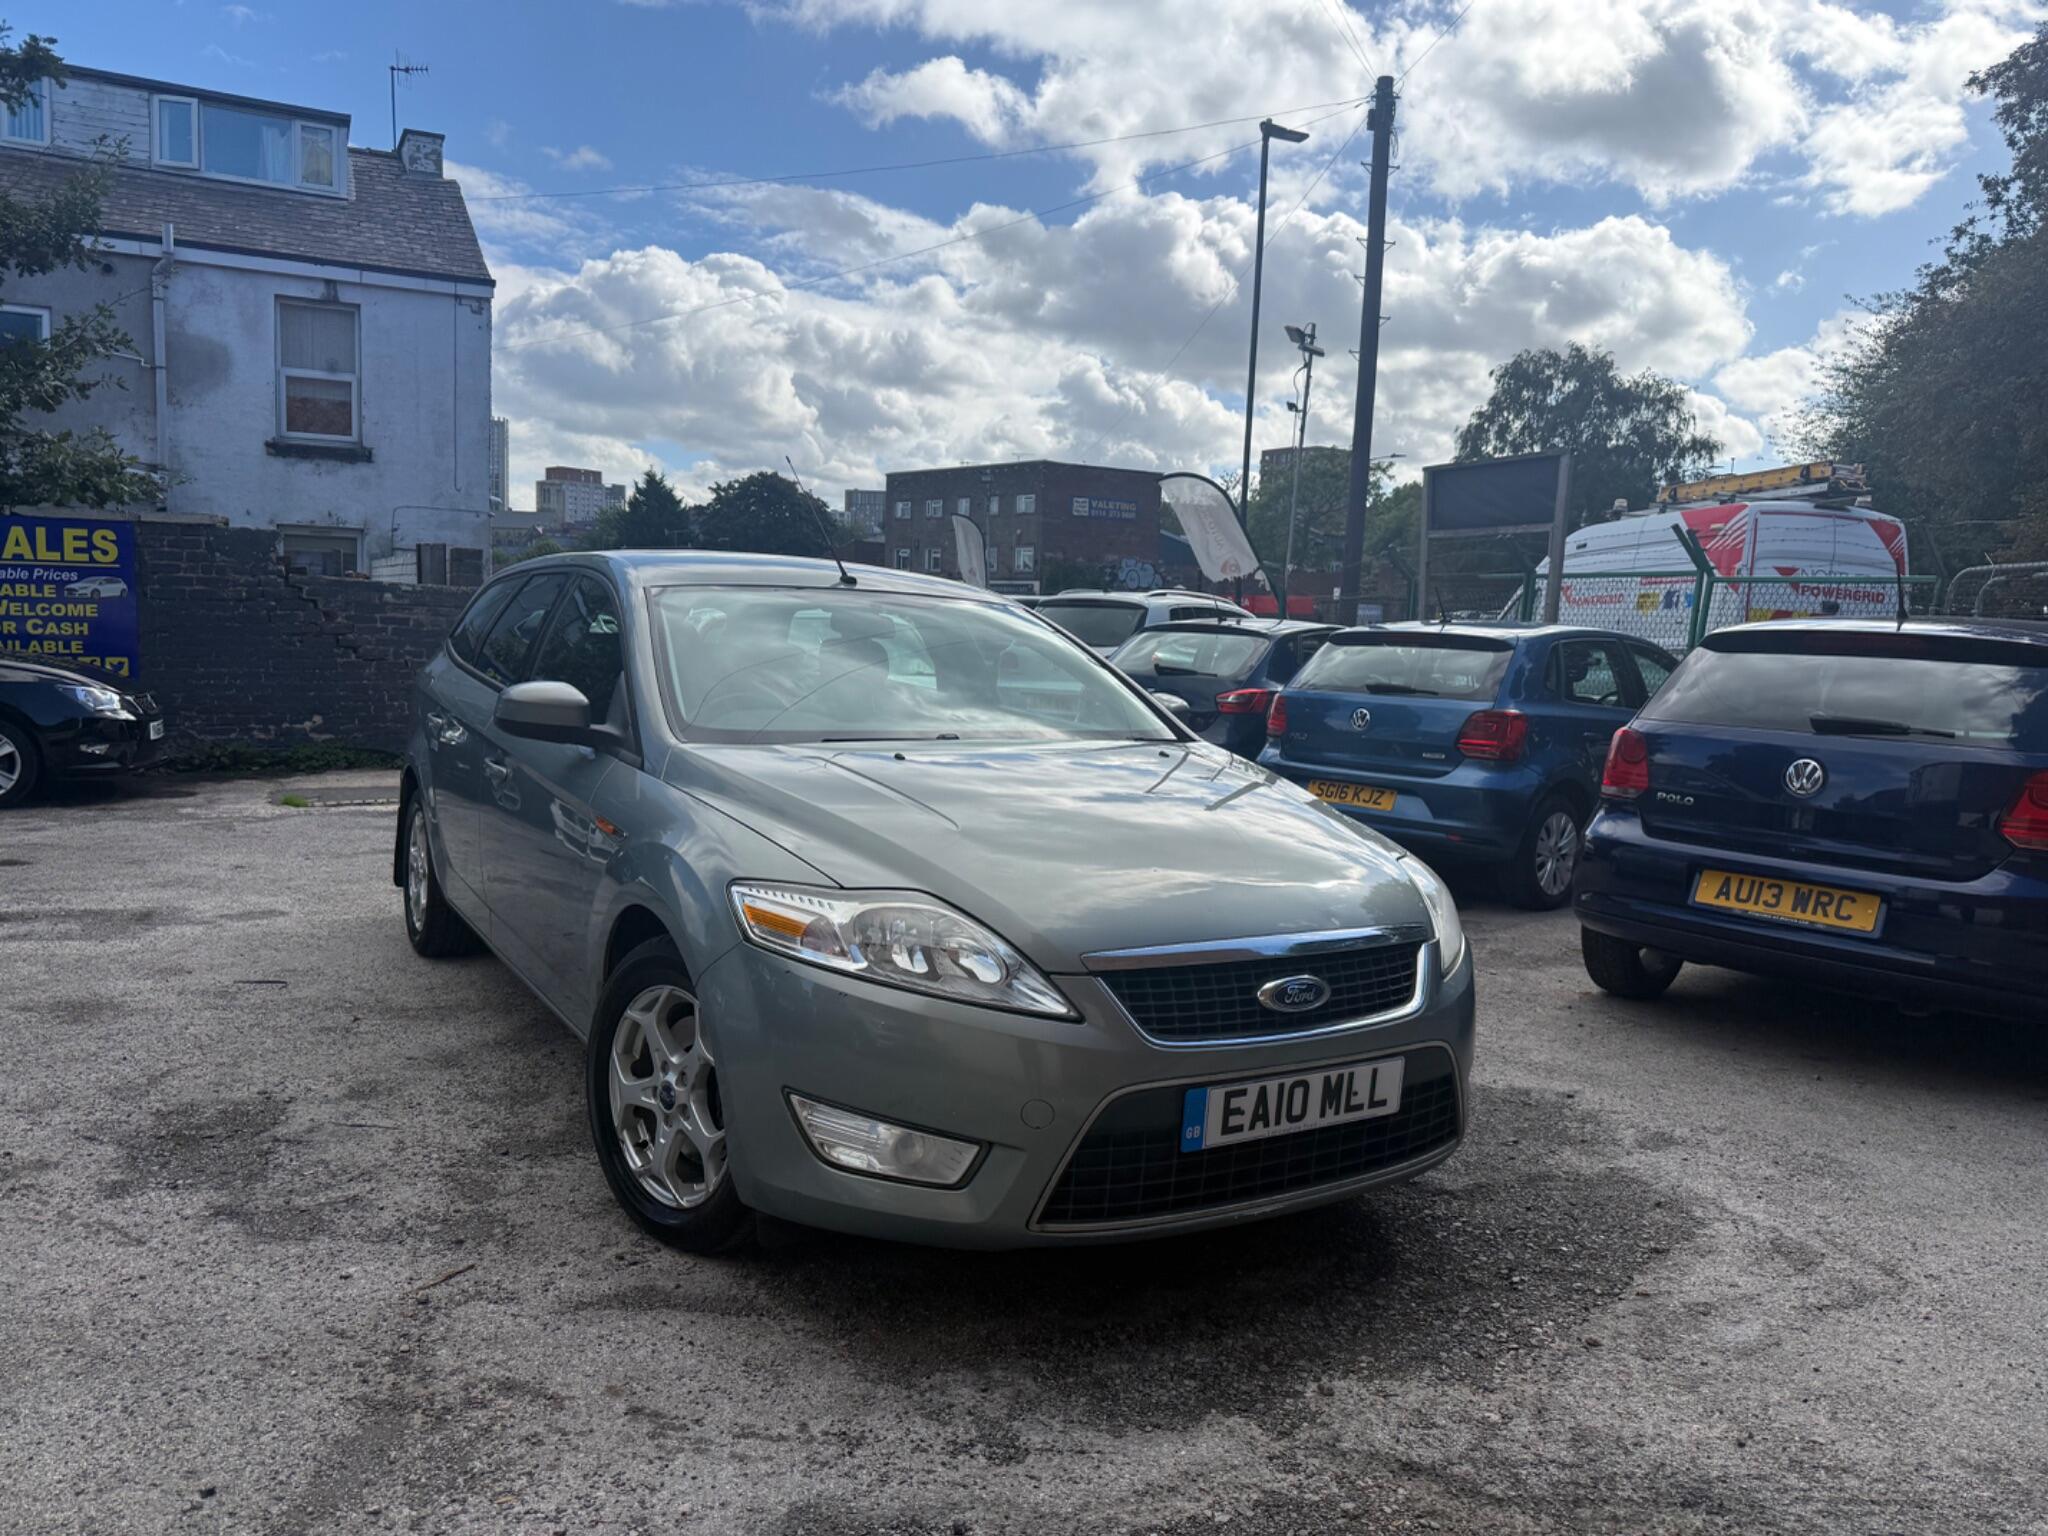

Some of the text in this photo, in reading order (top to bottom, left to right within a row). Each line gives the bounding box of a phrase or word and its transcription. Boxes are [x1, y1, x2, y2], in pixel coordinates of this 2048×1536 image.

[2, 526, 118, 562] ALES
[33, 568, 78, 581] Prices
[0, 583, 56, 597] ABLE
[1315, 780, 1386, 806] SG16 KJZ
[1656, 791, 1694, 806] POLO
[1713, 875, 1784, 909] AU13
[1795, 887, 1857, 921] WRC
[1284, 984, 1316, 1003] Ford
[1220, 1067, 1387, 1136] EA10 MLL
[1185, 1125, 1200, 1139] GB
